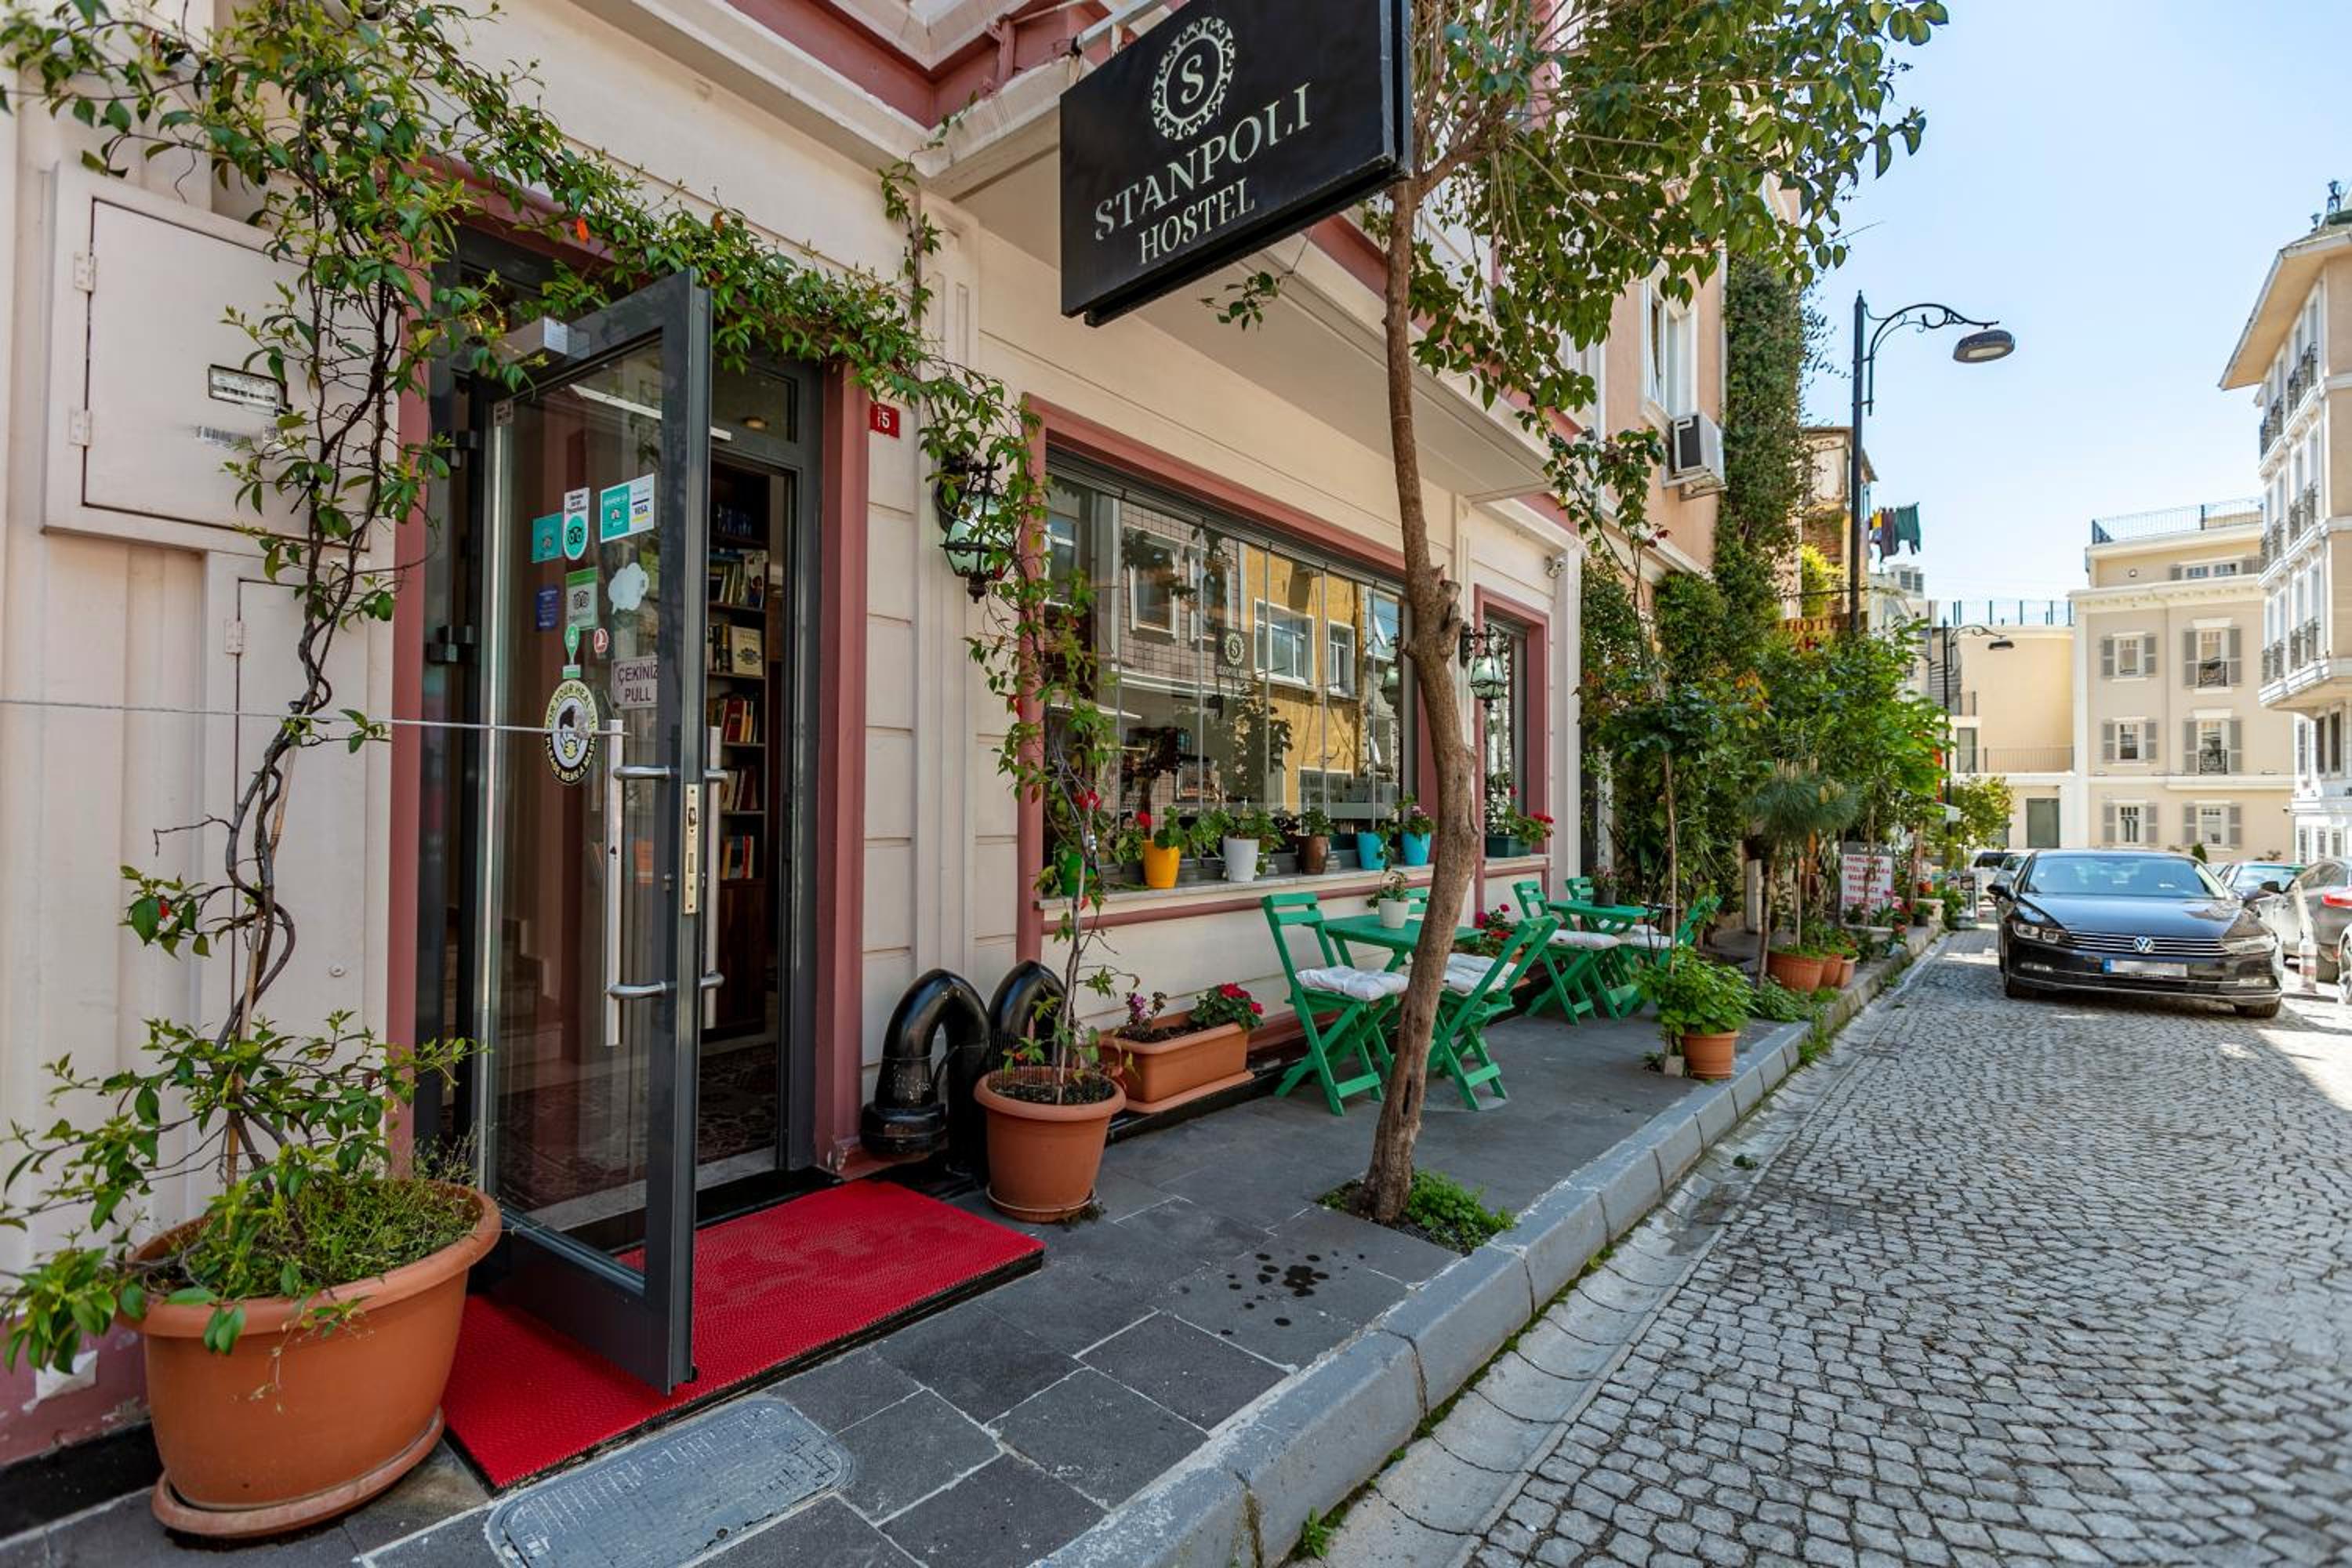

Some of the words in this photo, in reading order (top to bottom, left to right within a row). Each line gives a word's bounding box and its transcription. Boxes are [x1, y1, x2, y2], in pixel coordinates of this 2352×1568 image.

[1180, 53, 1205, 106] S
[1094, 82, 1313, 241] STANPOLI
[1138, 177, 1255, 265] HOSTEL
[618, 662, 659, 685] ÇEKİNİZ
[625, 686, 652, 703] PULL
